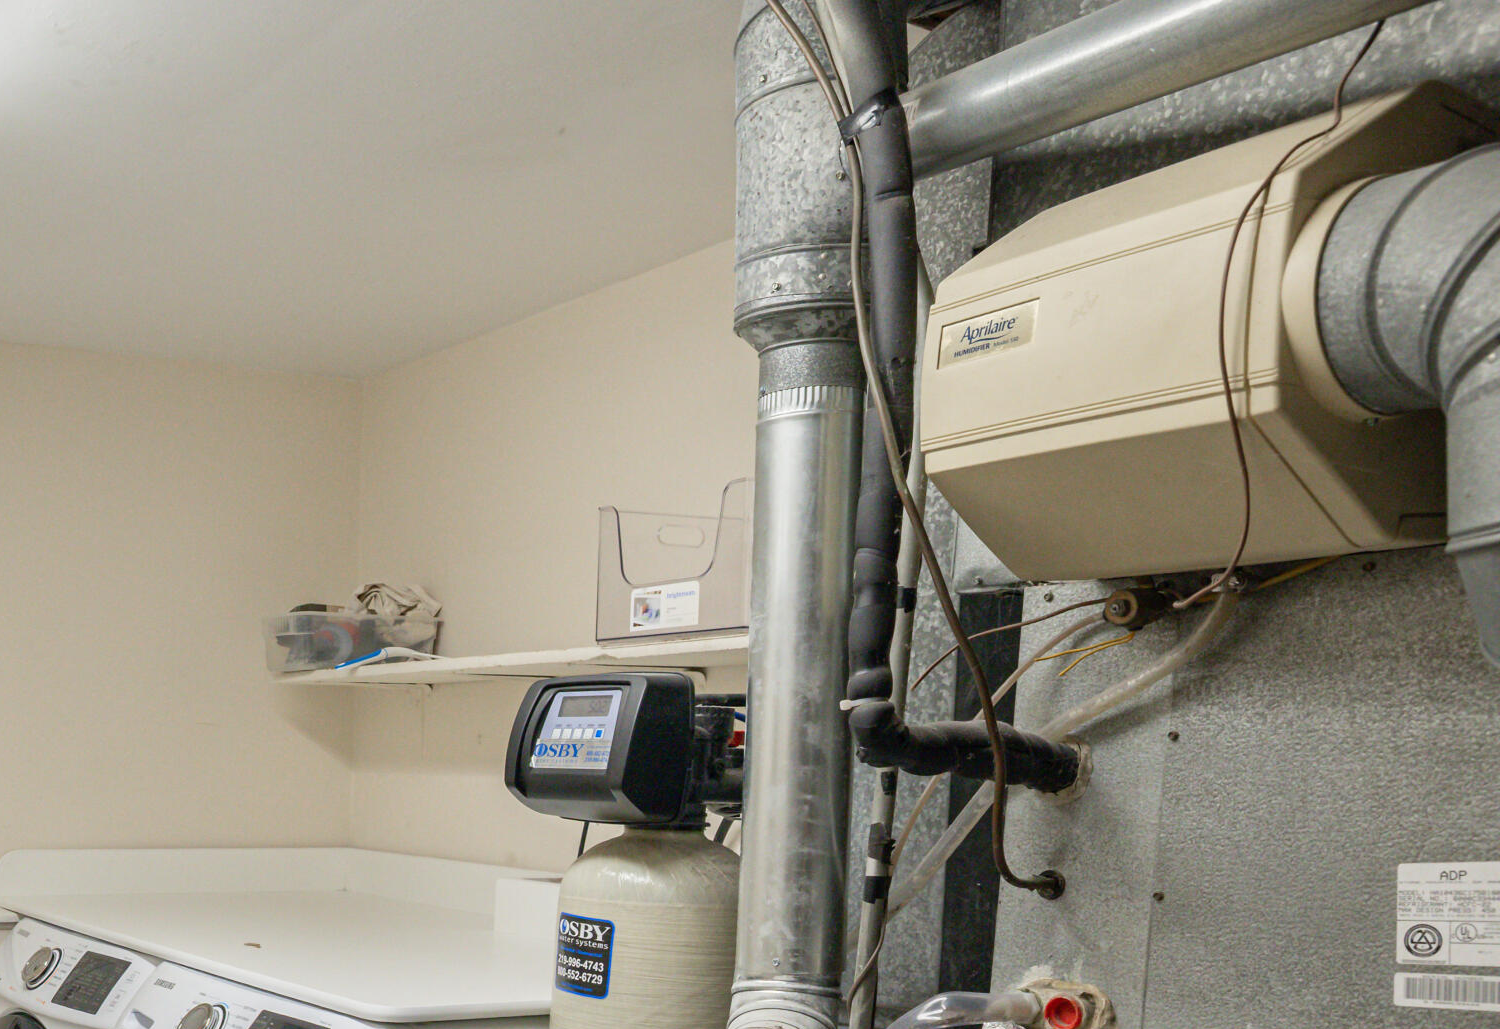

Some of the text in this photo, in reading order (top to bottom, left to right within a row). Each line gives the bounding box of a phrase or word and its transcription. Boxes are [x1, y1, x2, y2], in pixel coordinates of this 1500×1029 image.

[960, 317, 1016, 345] Aprilaire
[954, 343, 990, 358] HUMIDIFIER
[534, 743, 584, 758] OSBY
[1440, 870, 1467, 880] ADP
[560, 919, 611, 942] OSBY
[575, 939, 609, 949] systems
